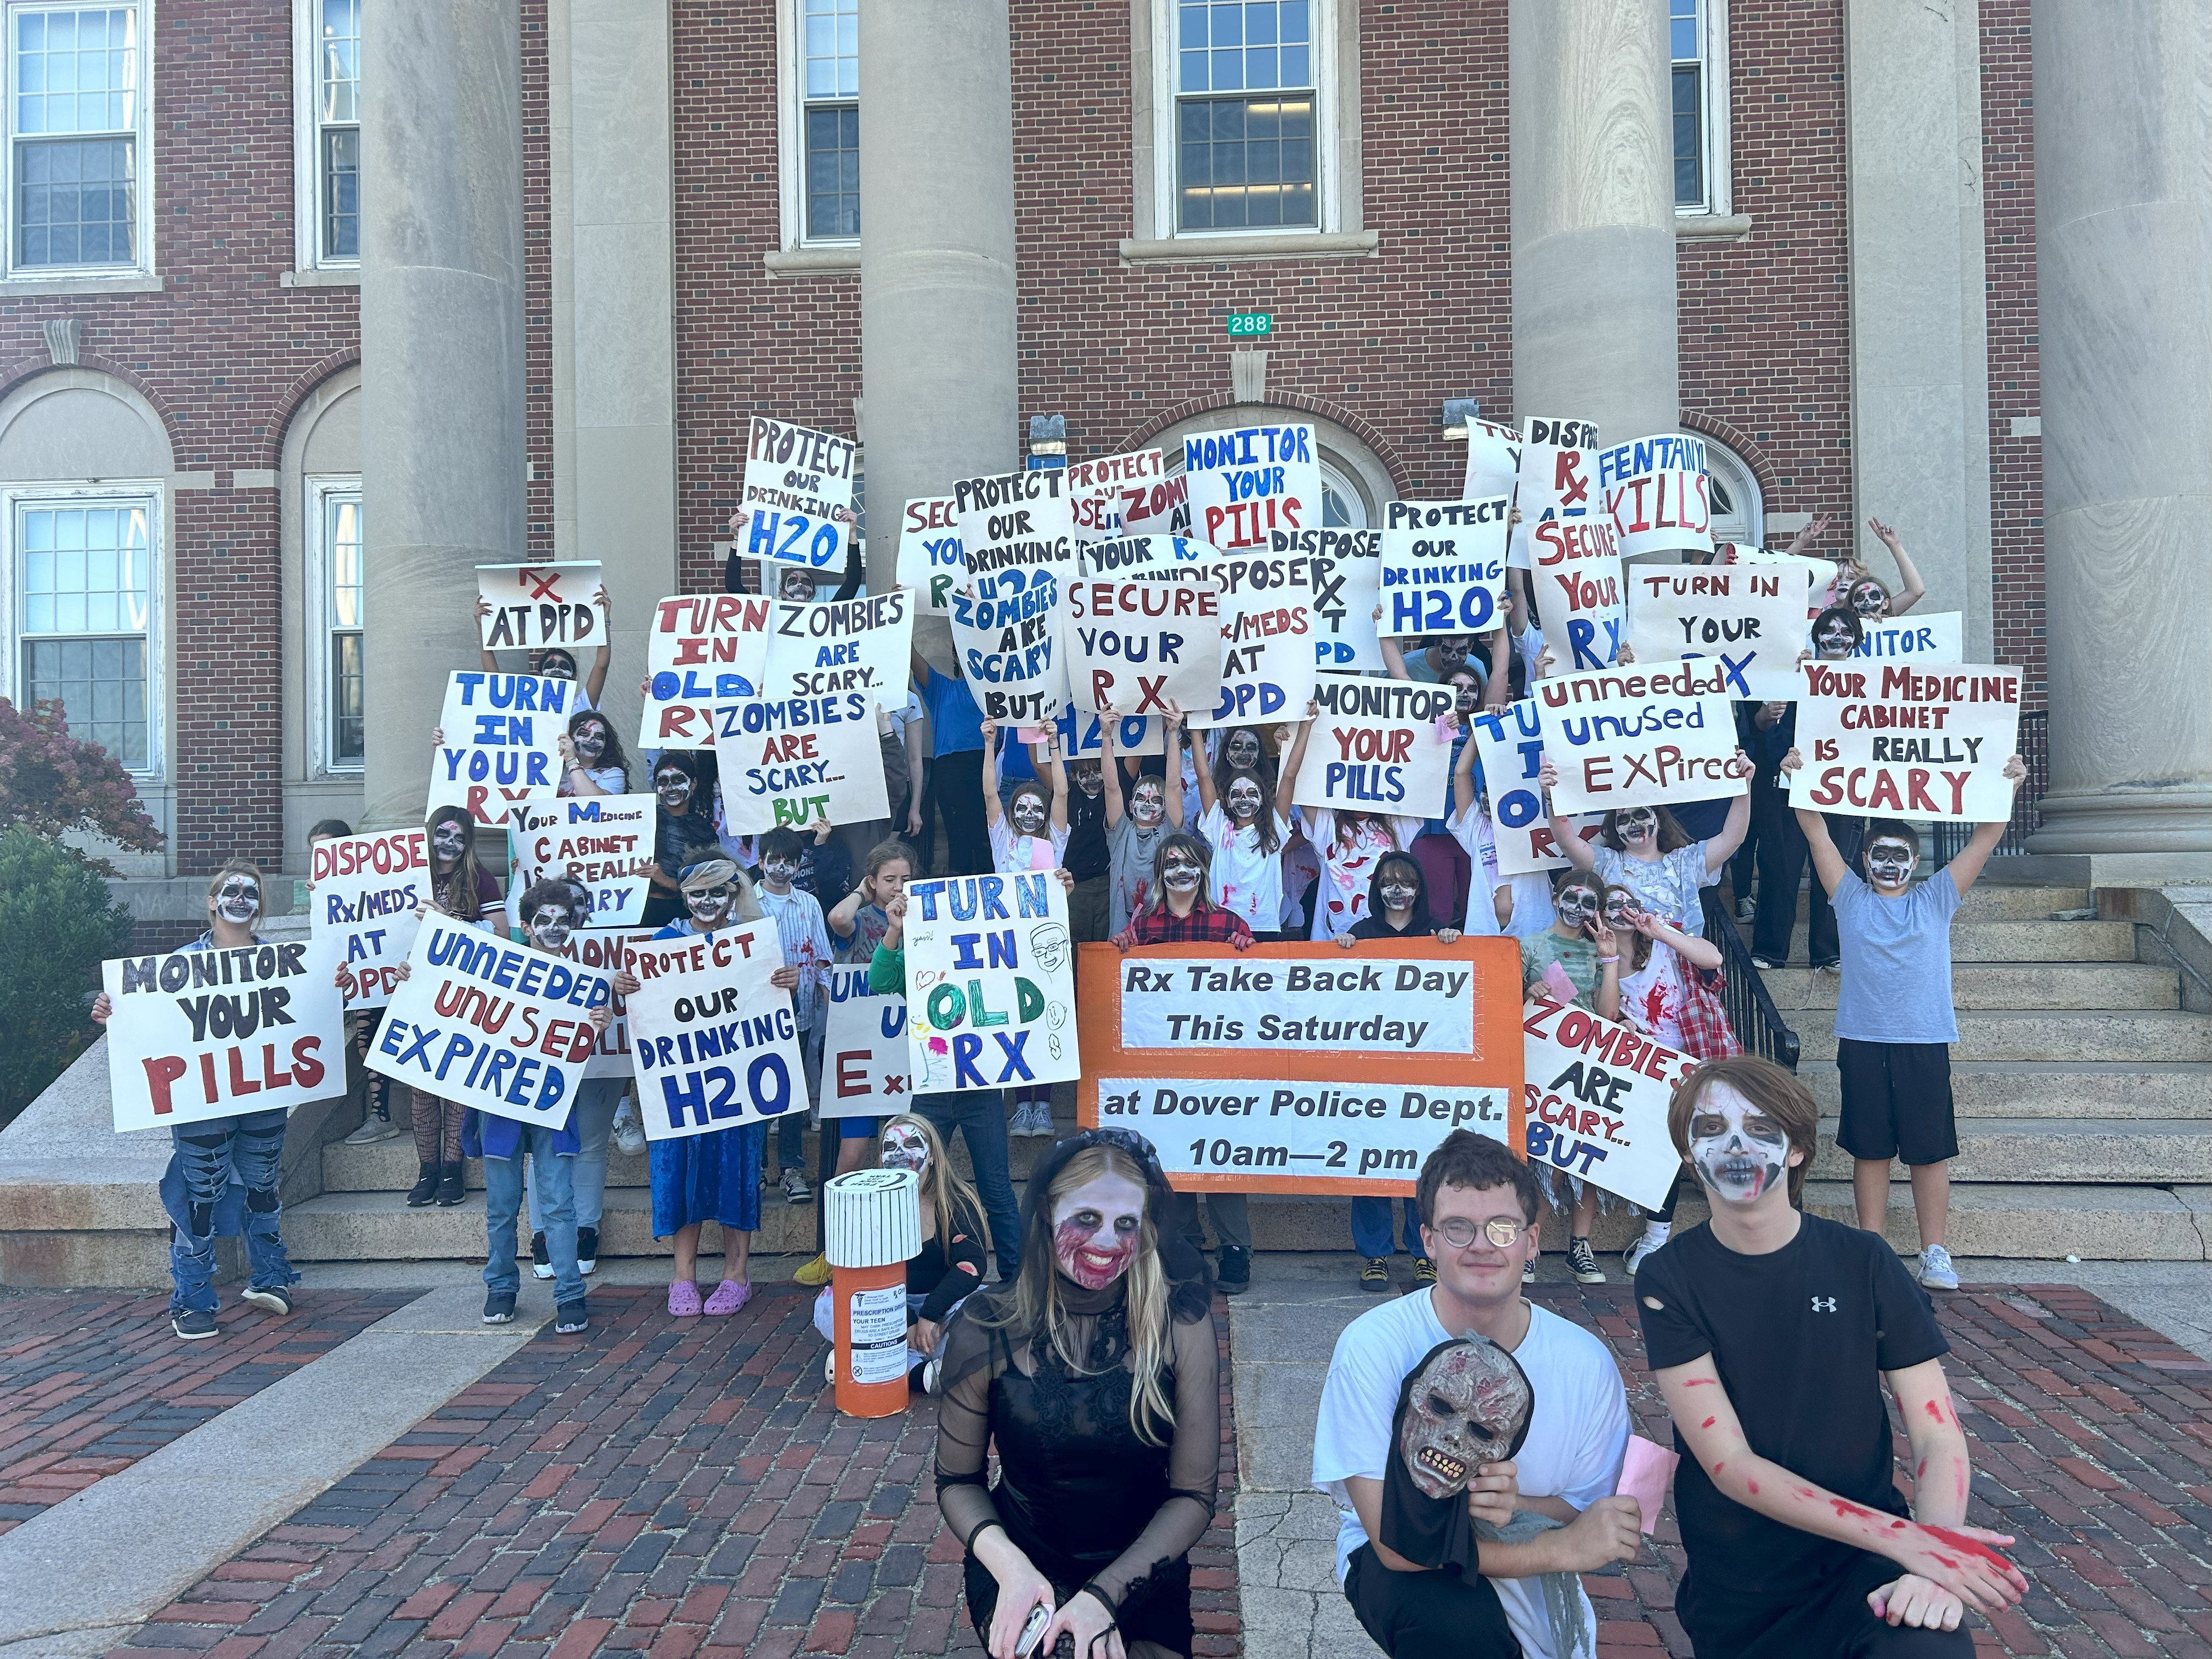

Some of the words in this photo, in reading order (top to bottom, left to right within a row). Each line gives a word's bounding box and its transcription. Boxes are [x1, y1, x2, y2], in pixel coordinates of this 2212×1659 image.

[1232, 316, 1266, 332] 288
[750, 418, 855, 479] PROTECT
[1186, 427, 1310, 472] MONITOR
[1532, 420, 1598, 450] DISPOSE
[783, 470, 821, 493] OUR
[1069, 452, 1162, 492] PROTECT
[1599, 438, 1708, 488] FENTANYL
[954, 469, 1063, 514] PROTECT
[1221, 466, 1285, 502] YOUR
[747, 486, 845, 522] DRINKING
[906, 500, 958, 533] SEC
[1389, 500, 1506, 530] PROTECT
[1606, 472, 1708, 538] KILLS
[748, 509, 838, 567] H2O
[988, 510, 1035, 540] OUR
[1536, 521, 1617, 566] SECURE
[965, 536, 1070, 575] DRINKING
[1086, 537, 1154, 573] YOUR
[1271, 530, 1381, 559] DISPOSE
[1412, 540, 1458, 557] OUR
[1384, 560, 1503, 586] DRINKING
[1554, 571, 1620, 612] YOUR
[1644, 575, 1729, 598] TURN
[1750, 575, 1779, 597] IN
[658, 596, 770, 635] TURN
[777, 594, 904, 637] ZOMBIES
[952, 578, 1057, 630] ZOMBIES
[1069, 582, 1218, 619] SECURE
[1393, 586, 1494, 633] H2O
[486, 606, 531, 646] AT
[540, 604, 594, 645] DPD
[998, 616, 1046, 653] ARE
[1678, 616, 1762, 643] YOUR
[1850, 628, 1937, 658] NITOR
[673, 636, 738, 665] IN
[815, 641, 859, 668] ARE
[967, 636, 1052, 683] SCARY
[1077, 627, 1183, 664] YOUR
[1223, 644, 1265, 679] AT
[1315, 642, 1355, 664] PD
[456, 673, 567, 714] TURN
[652, 671, 755, 701] OLD
[1804, 665, 1866, 698] YOUR
[1881, 666, 2017, 704] MEDICINE
[715, 693, 866, 739] ZOMBIES
[1313, 684, 1452, 724] MONITOR
[1841, 705, 1949, 729] CABINET
[473, 715, 533, 746] IN
[1332, 727, 1414, 763] YOUR
[443, 748, 551, 786] YOUR
[761, 734, 819, 765] ARE
[1815, 738, 1839, 761] IS
[1872, 736, 1984, 764] REALLY
[1326, 762, 1405, 802] PILLS
[1810, 767, 1972, 815] SCARY
[511, 805, 558, 832] YOUR
[568, 802, 642, 825] MEDICINE
[772, 794, 830, 827] BUT
[314, 833, 428, 881] DISPOSE
[535, 835, 638, 864] CABINET
[523, 866, 544, 889] IS
[567, 856, 653, 883] REALLY
[585, 888, 634, 913] ARY
[911, 873, 1049, 922] TURN
[348, 929, 386, 964] AT
[624, 933, 755, 980] PROTECT
[951, 929, 1018, 970] IN
[122, 943, 307, 995] MONITOR
[1126, 967, 1174, 992] Rx
[1187, 966, 1273, 992] Take
[1286, 966, 1383, 991] Back
[1395, 965, 1469, 998] Day
[177, 986, 296, 1041] YOUR
[674, 988, 738, 1022] OUR
[928, 977, 1045, 1030] OLD
[637, 1008, 794, 1070] DRINKING
[1166, 1014, 1243, 1040] This
[1257, 1014, 1429, 1048] Saturday
[142, 1036, 325, 1115] PILLS
[380, 1019, 565, 1111] EXPIRED
[952, 1030, 1036, 1089] RX
[661, 1052, 791, 1129] H2O
[1548, 1060, 1633, 1114] ARE
[1104, 1089, 1141, 1115] at
[1153, 1089, 1260, 1116] Dover
[1269, 1090, 1387, 1118] Police
[1400, 1092, 1503, 1127] Dept.
[1358, 1147, 1418, 1175] pm
[1526, 1121, 1609, 1176] BUT
[853, 1307, 894, 1316] PRESCRIPTION
[870, 1339, 898, 1348] CAUTIONS
